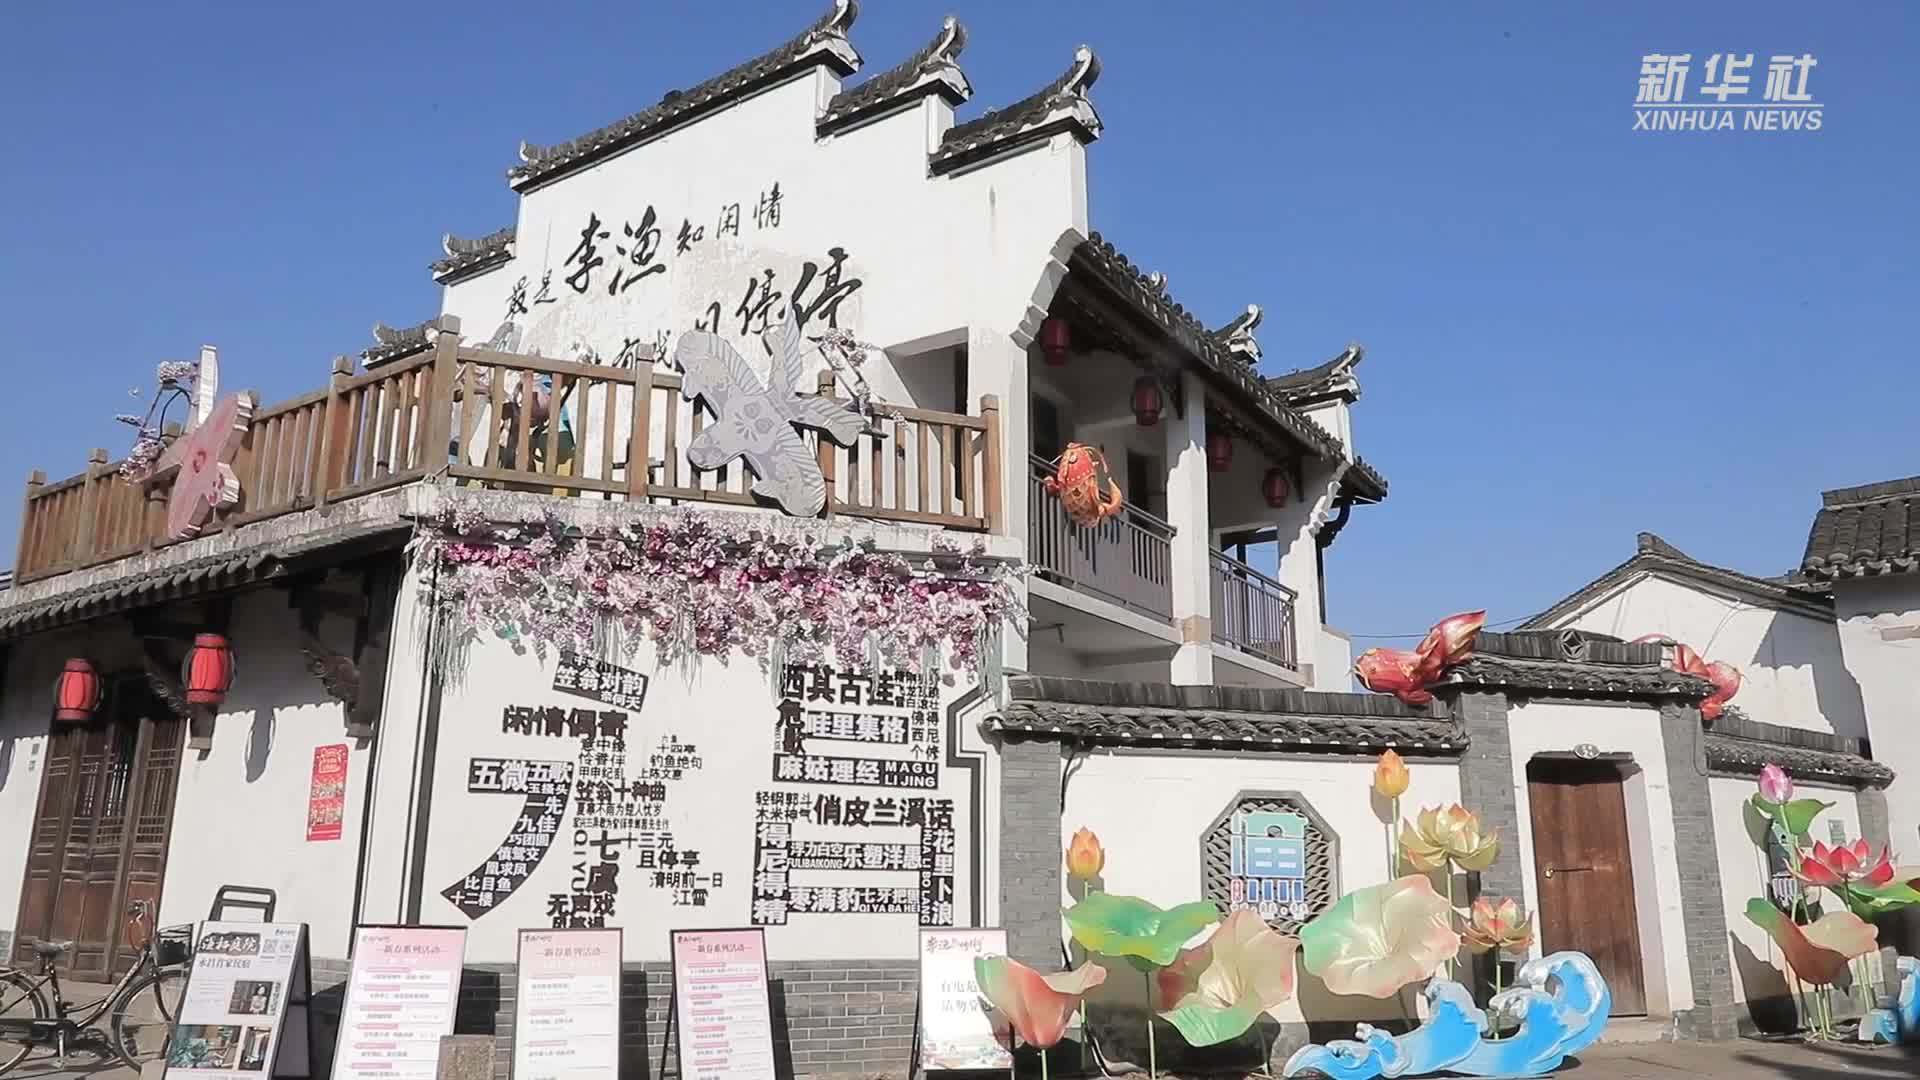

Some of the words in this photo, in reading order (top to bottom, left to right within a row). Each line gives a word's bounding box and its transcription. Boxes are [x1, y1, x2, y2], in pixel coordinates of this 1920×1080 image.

[469, 760, 529, 792] 五微
[884, 761, 936, 775] MAGU
[900, 775, 936, 788] JING
[526, 795, 563, 815] 一先
[517, 814, 556, 833] 九佳
[621, 832, 675, 849] 十三元
[636, 850, 700, 870] 且停亭
[464, 875, 512, 892] 比目鱼
[650, 871, 723, 888] 清明前一日
[932, 829, 954, 924] 花里卜浪
